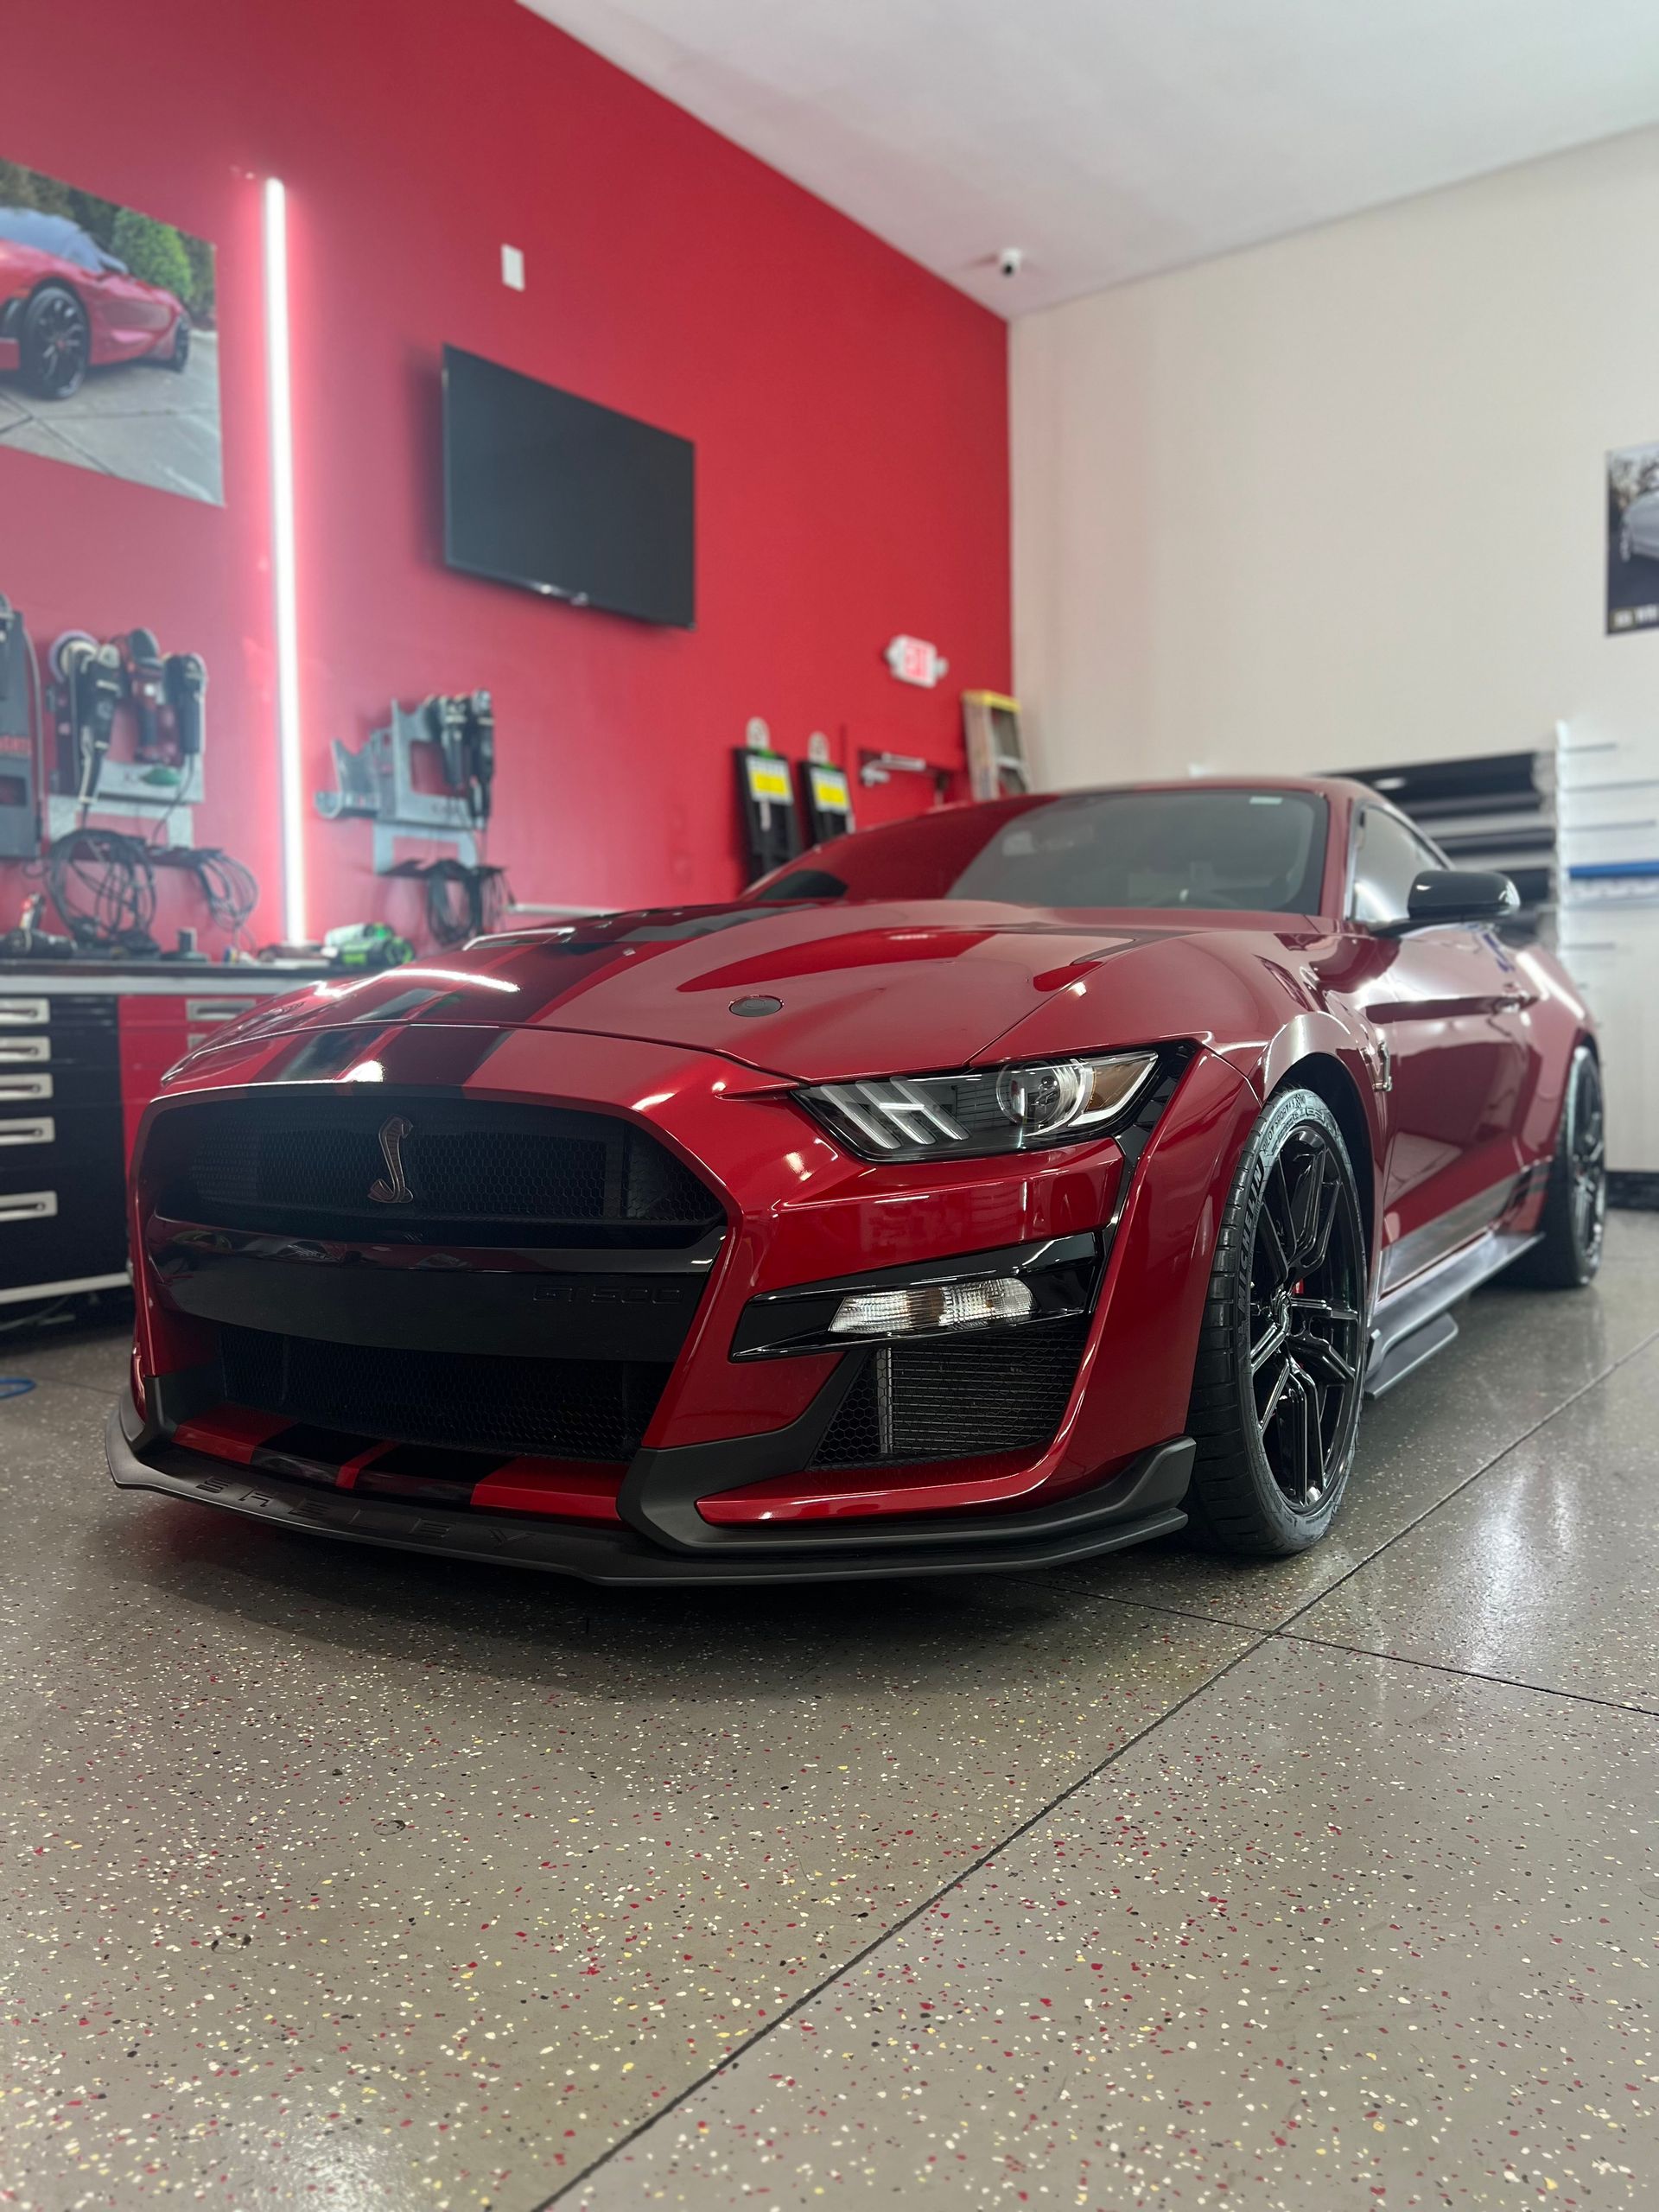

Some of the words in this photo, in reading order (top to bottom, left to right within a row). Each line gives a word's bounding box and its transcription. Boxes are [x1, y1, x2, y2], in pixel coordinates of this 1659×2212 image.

[1262, 1125, 1274, 1154] PILOT
[1237, 1162, 1263, 1313] MICHELIN
[532, 1285, 684, 1305] GT500
